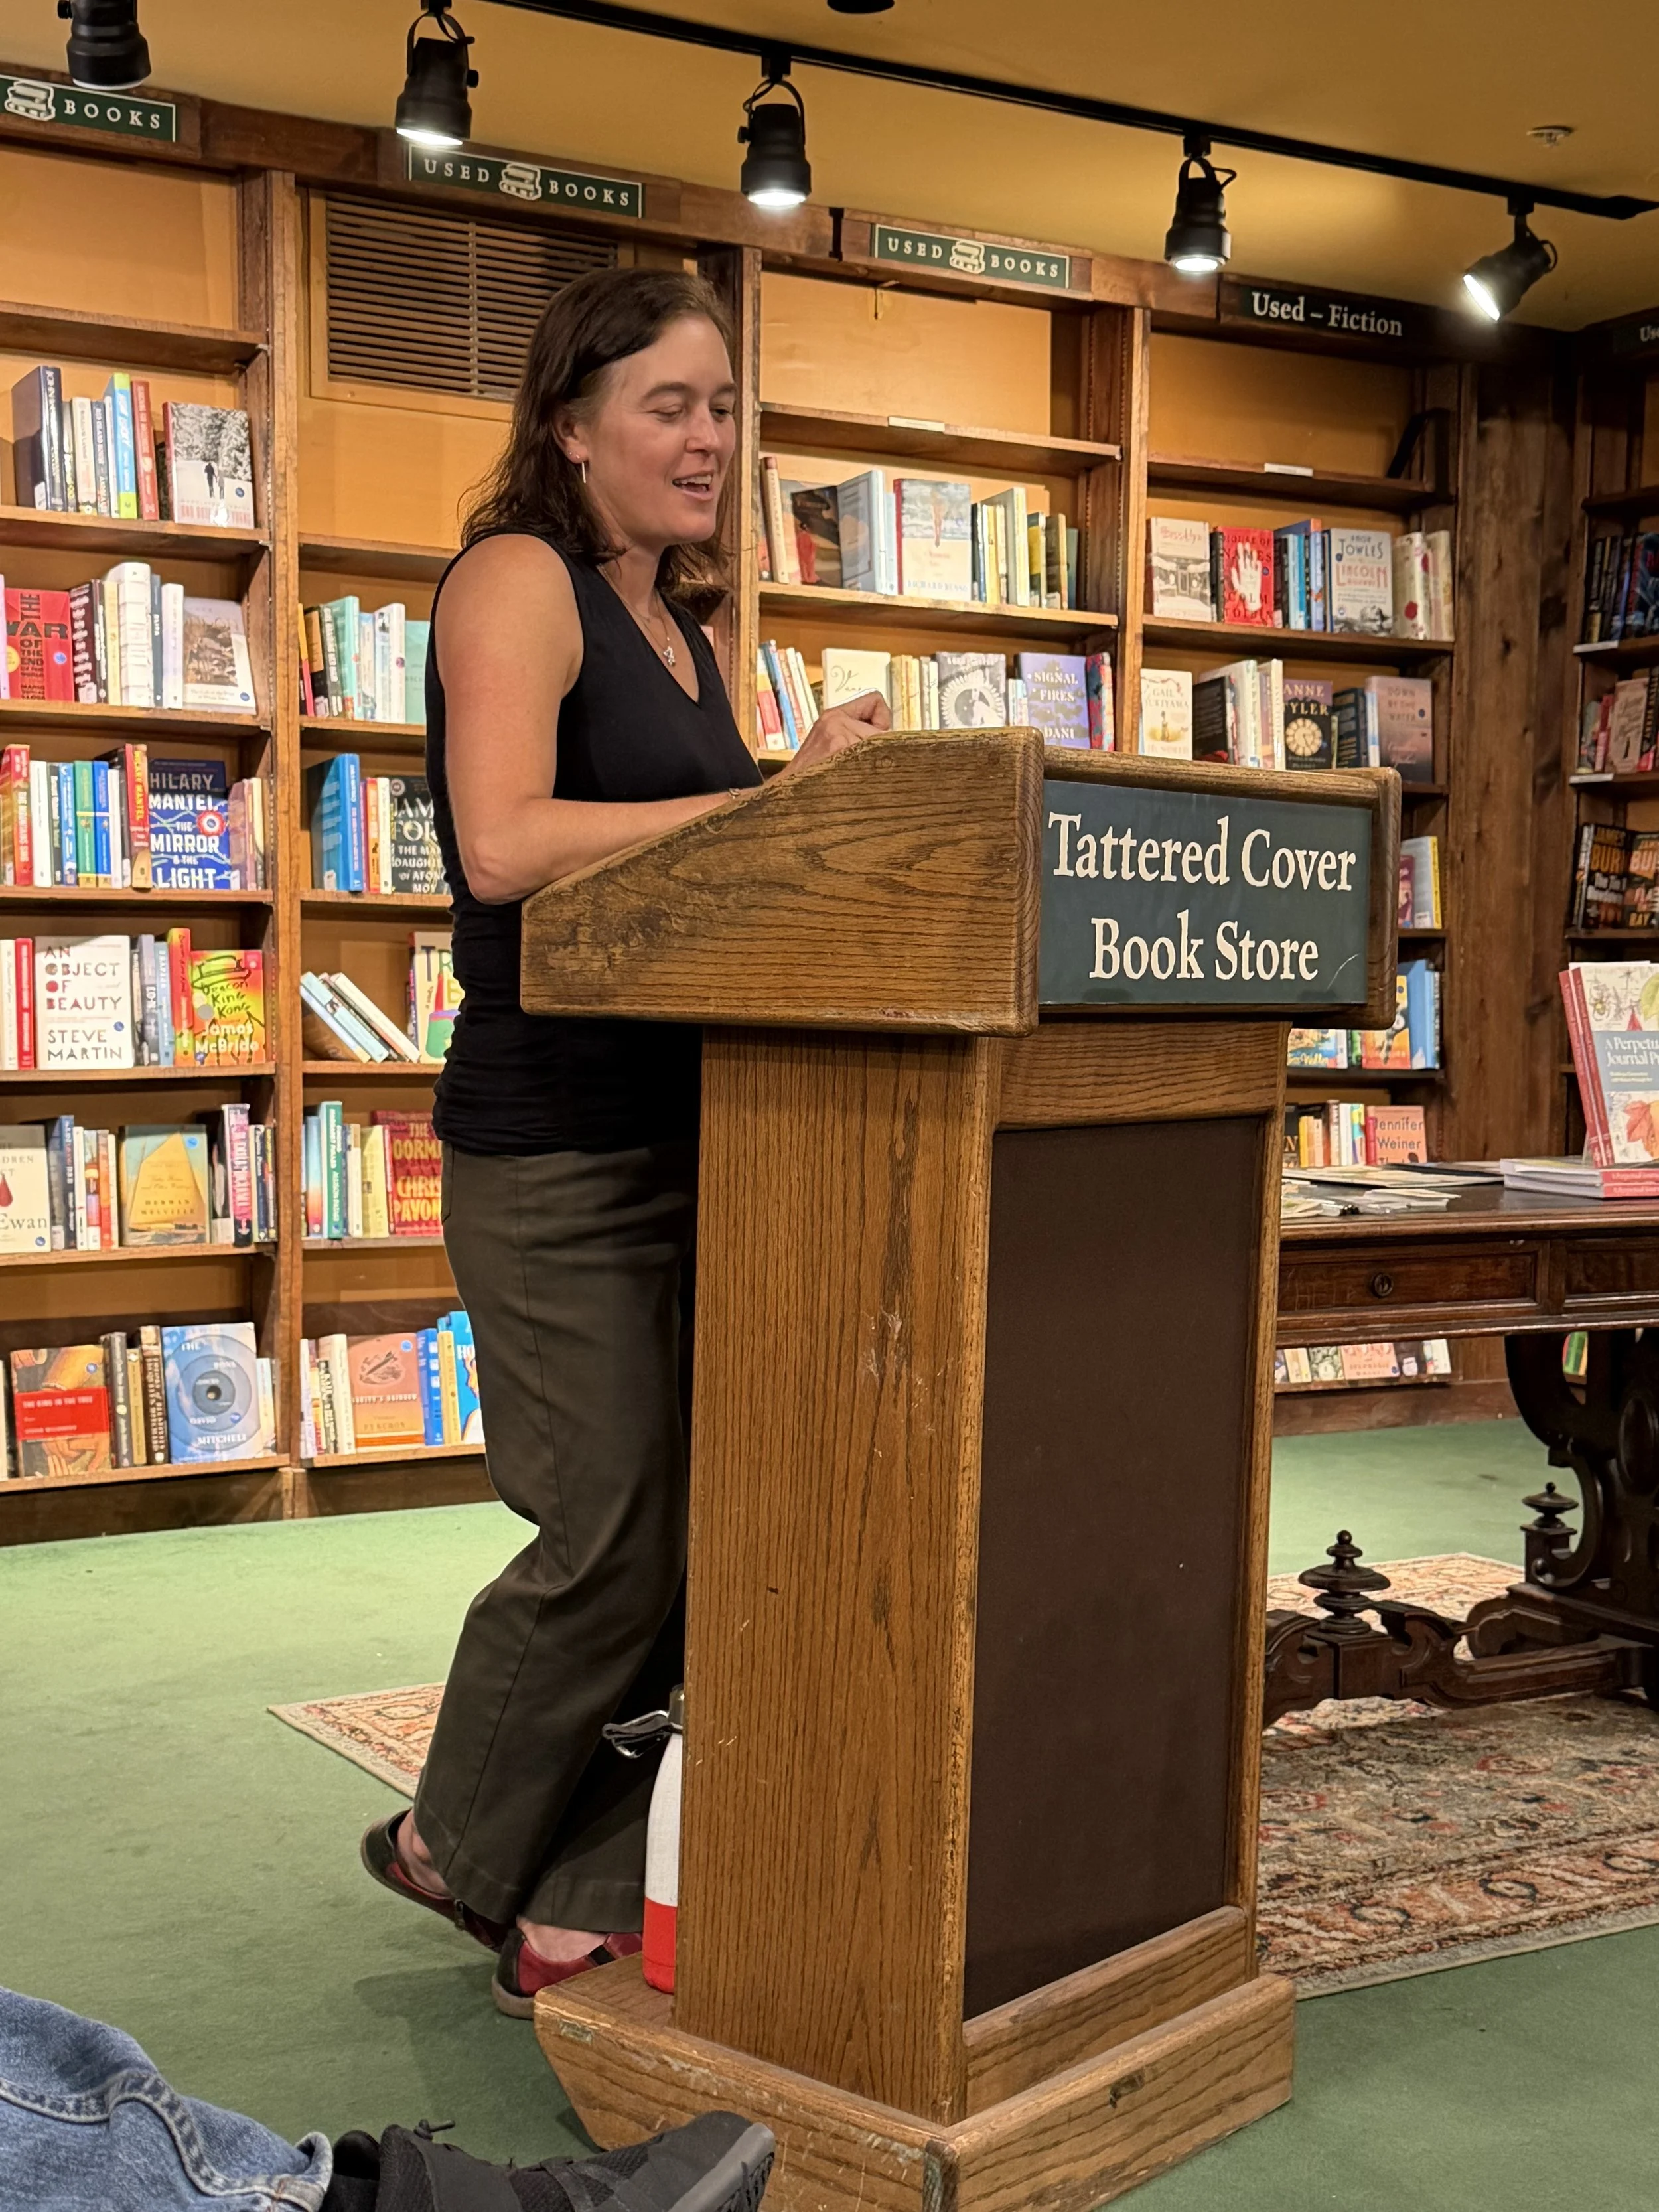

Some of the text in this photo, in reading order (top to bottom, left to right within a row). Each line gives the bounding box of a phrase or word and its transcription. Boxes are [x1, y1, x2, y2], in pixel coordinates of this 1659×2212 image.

[64, 98, 161, 131] BOOKS
[423, 158, 630, 208] USED BOOKS
[887, 236, 1059, 278] USED BOOKS
[1252, 292, 1305, 322] Used
[1327, 304, 1402, 336] Fiction
[1336, 538, 1383, 561] TOWLES
[20, 593, 41, 621] THE
[6, 621, 68, 640] WAR
[20, 639, 43, 648] OF
[1033, 672, 1078, 685] SIGNAL
[1039, 690, 1075, 702] FIRES
[1284, 684, 1325, 698] ANNE
[1043, 726, 1075, 739] DANI
[149, 772, 214, 790] HILARY
[135, 784, 145, 820] MANTEL
[149, 794, 218, 811] MANTEL
[394, 797, 435, 818] JAM
[175, 821, 193, 832] THE
[397, 819, 438, 842] FOR
[150, 834, 220, 853] MIRROR
[398, 844, 417, 855] THE
[1048, 812, 1356, 891] Tattered Cover
[157, 867, 217, 889] LIGHT
[44, 946, 72, 959] AN
[1090, 909, 1319, 980] Book Store
[44, 962, 121, 977] OBJECT
[421, 945, 453, 982] TR
[46, 980, 72, 994] OF
[46, 996, 121, 1011] BEAUTY
[48, 1029, 108, 1044] STEVE
[202, 1022, 253, 1037] James
[47, 1046, 123, 1061] MARTIN
[195, 1037, 259, 1054] McBride
[1605, 1037, 1659, 1054] A Perpetu
[1607, 1050, 1649, 1067] Journal
[409, 1122, 428, 1138] THE
[1375, 1116, 1423, 1131] Jennifer
[1378, 1136, 1421, 1149] Weiner
[2, 1155, 34, 1163] DREN
[397, 1175, 441, 1198] CHRIS
[393, 1199, 441, 1222] PAVON
[0, 1212, 48, 1230] Ewan
[196, 1433, 248, 1445] MITCHELL
